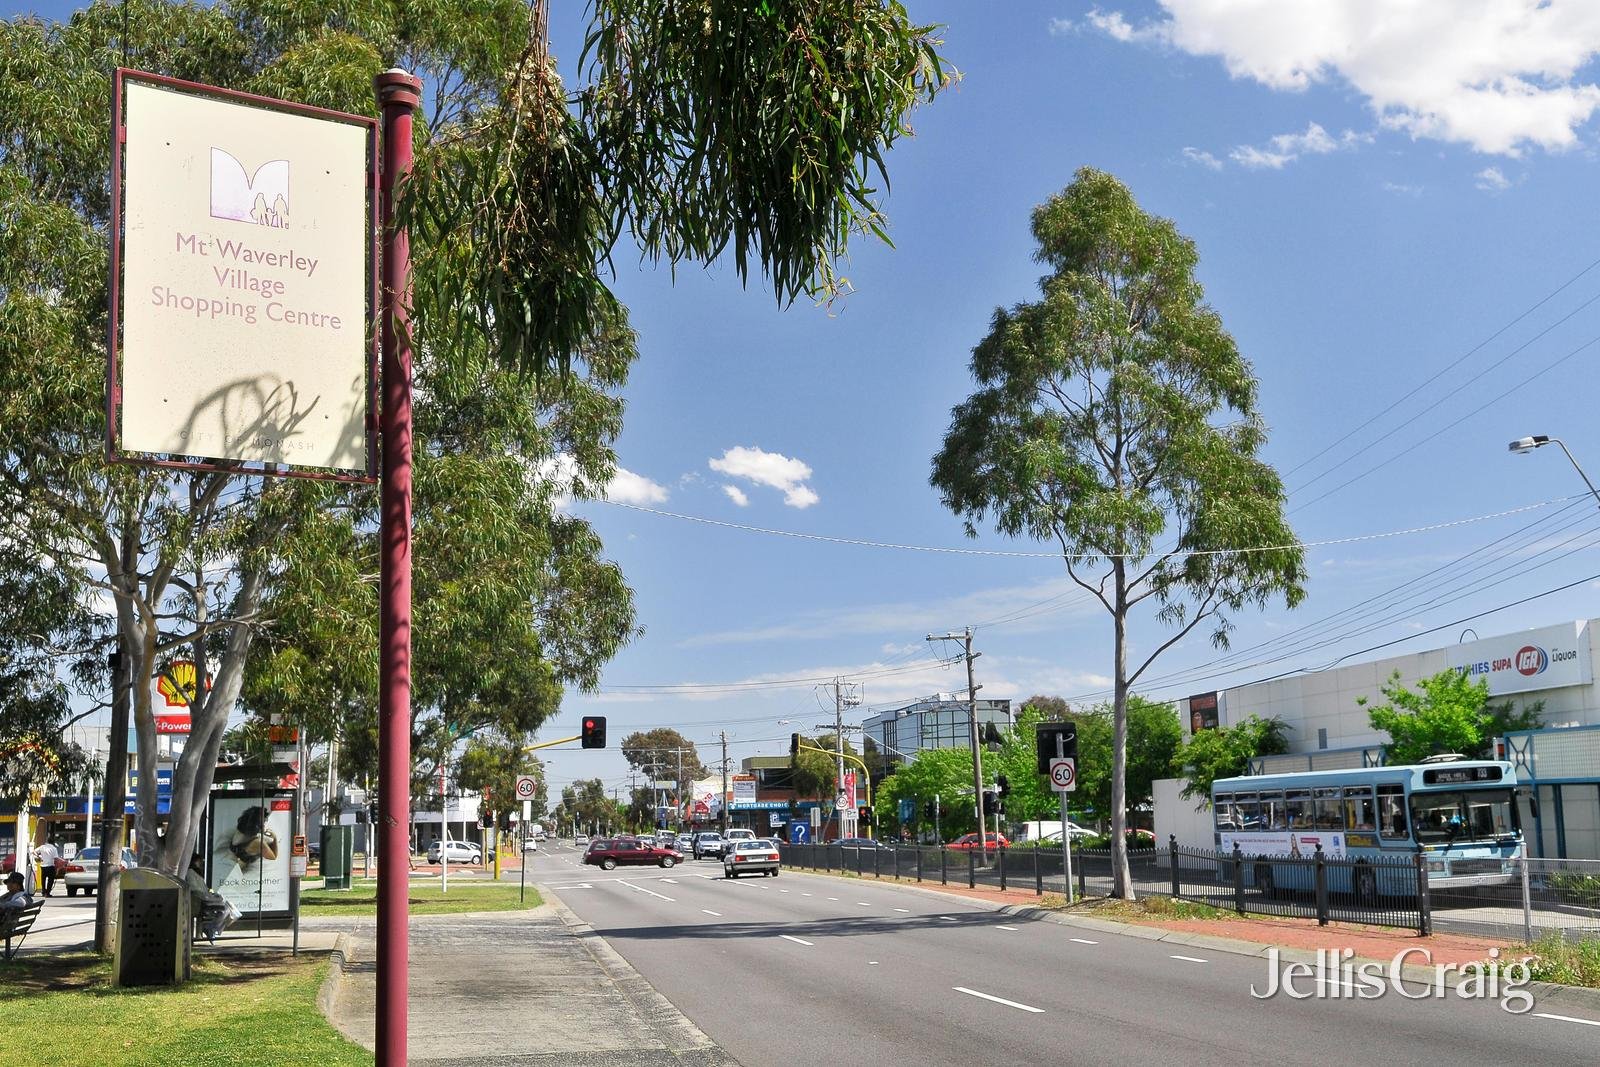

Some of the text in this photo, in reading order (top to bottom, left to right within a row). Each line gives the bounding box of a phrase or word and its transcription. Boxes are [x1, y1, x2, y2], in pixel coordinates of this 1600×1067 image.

[176, 232, 318, 277] Mt Waverley
[213, 266, 285, 298] Village
[151, 286, 342, 330] Shopping Centre
[180, 430, 314, 451] CITY OF MONASH
[1491, 657, 1512, 672] SUPA
[1518, 650, 1539, 670] IGA
[1552, 650, 1577, 663] LIQUOR
[1055, 768, 1071, 780] 60
[519, 783, 532, 792] 60
[219, 878, 239, 887] Back
